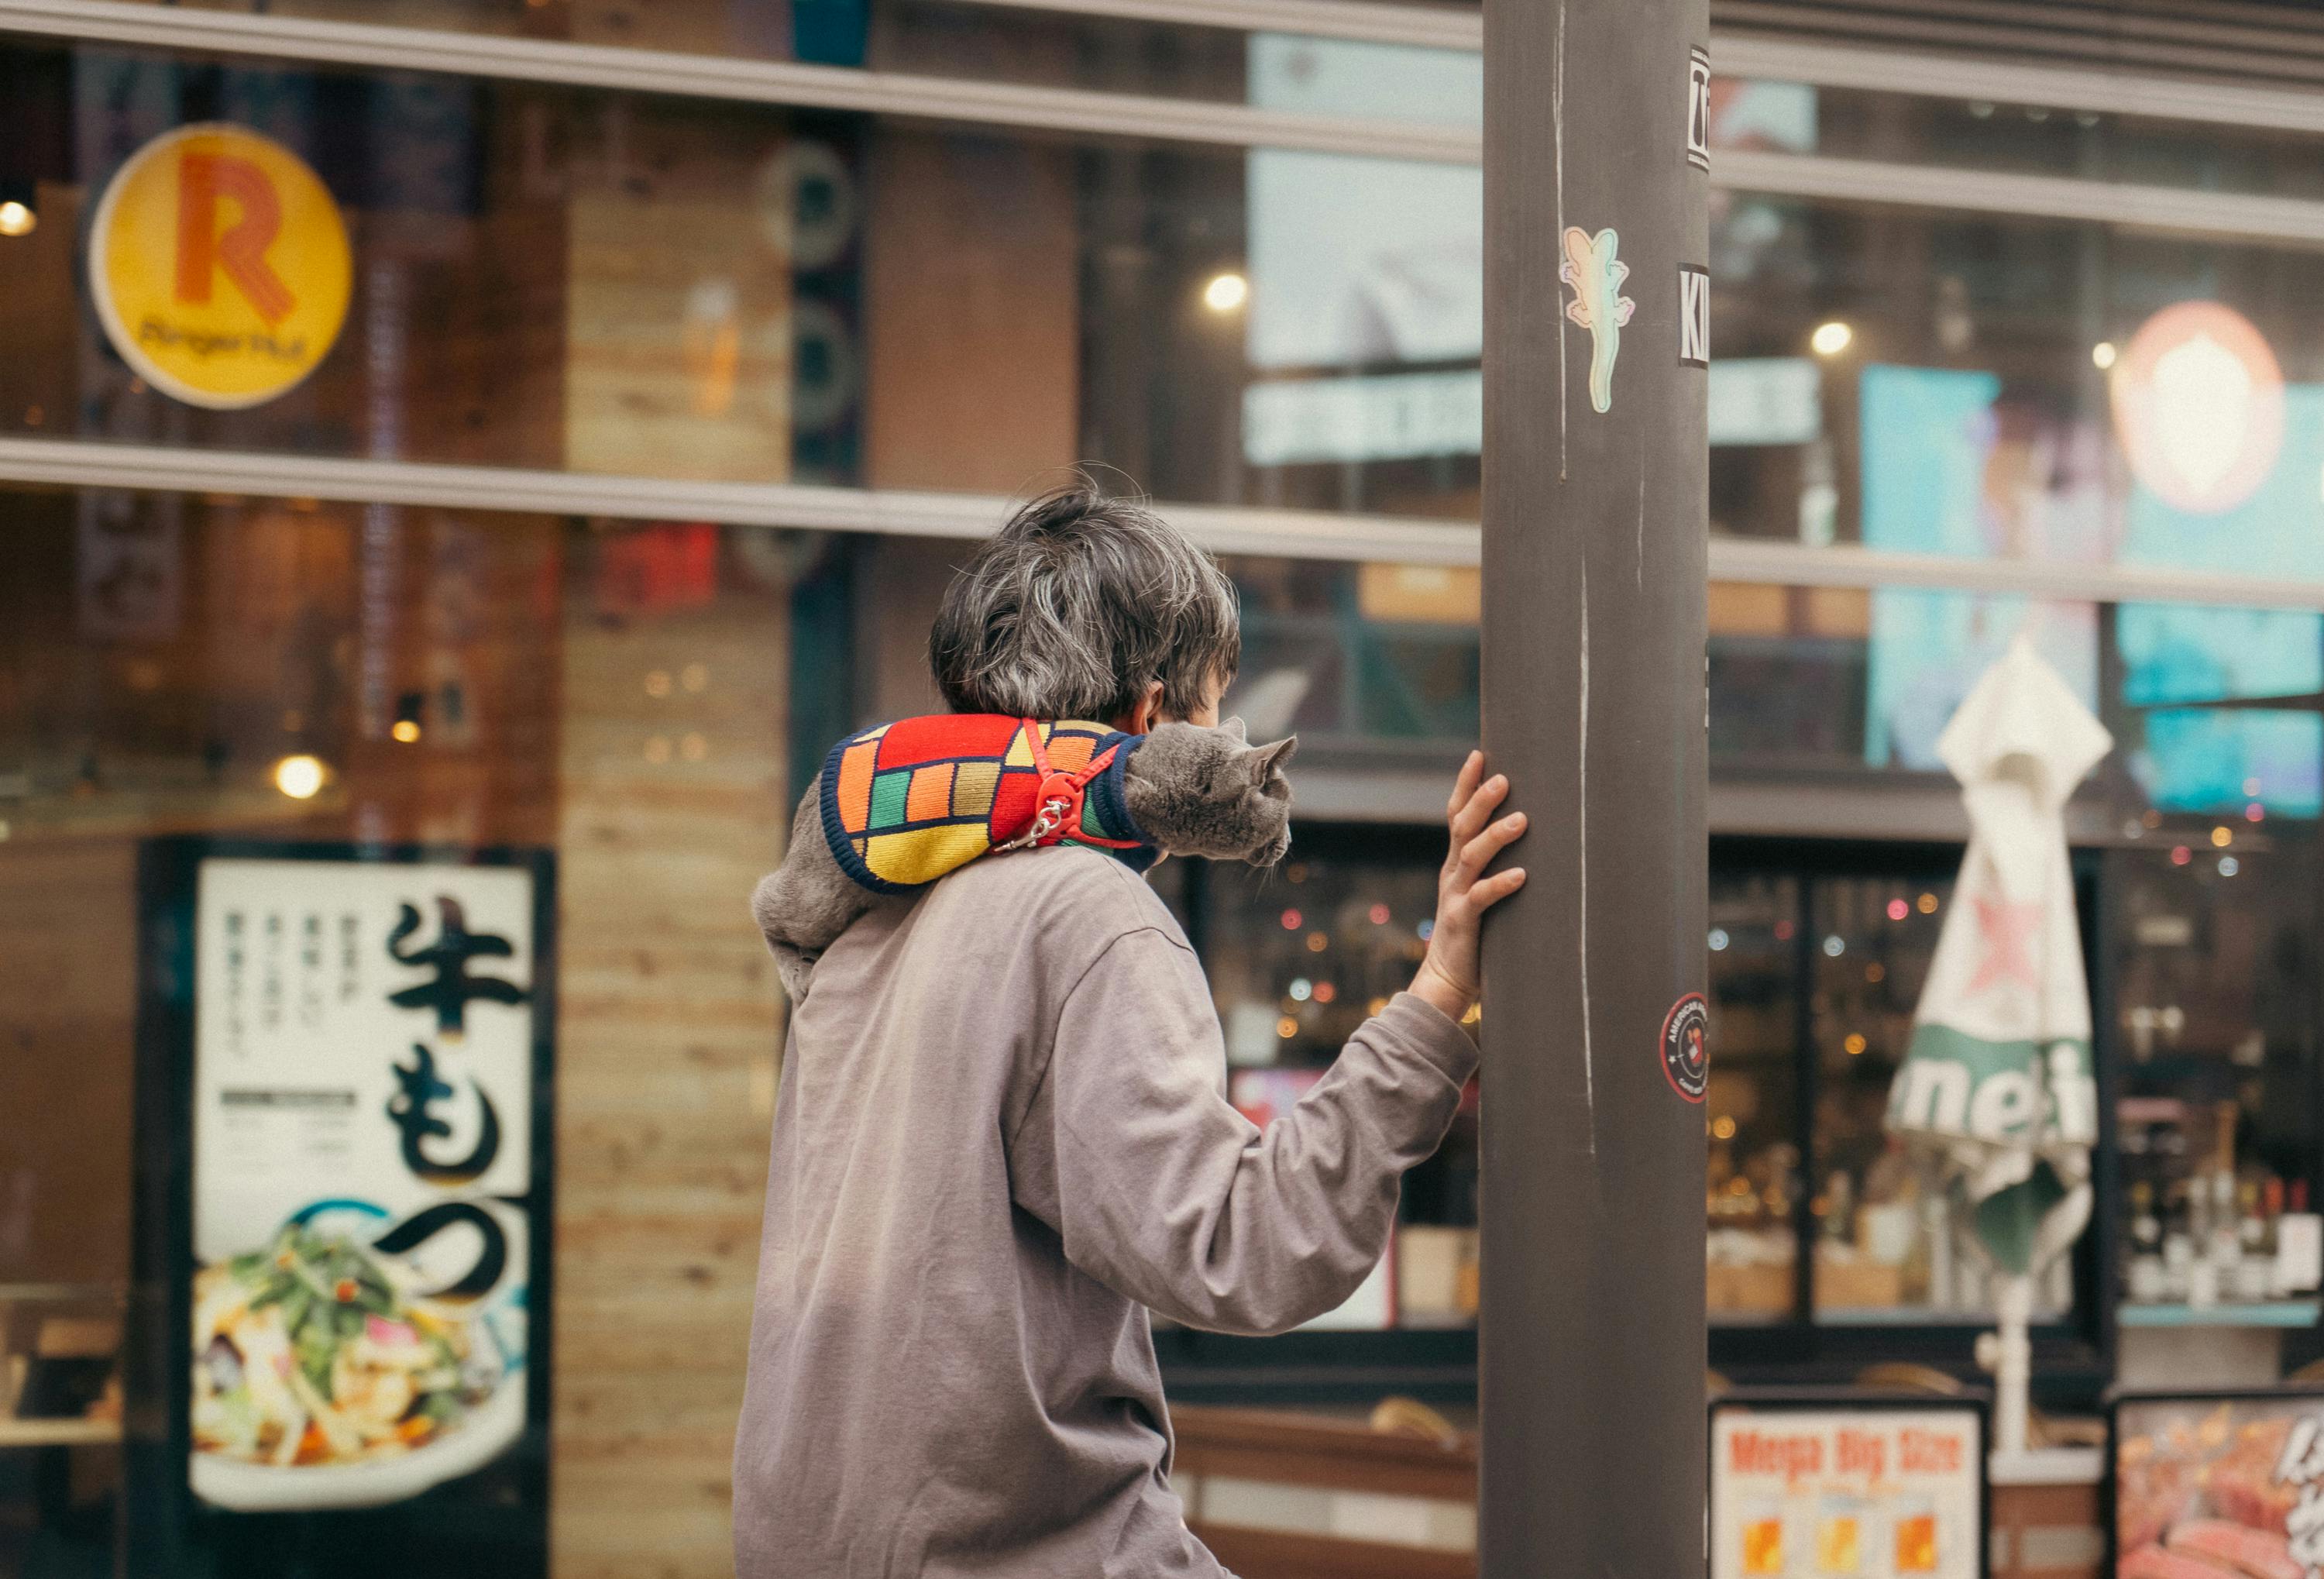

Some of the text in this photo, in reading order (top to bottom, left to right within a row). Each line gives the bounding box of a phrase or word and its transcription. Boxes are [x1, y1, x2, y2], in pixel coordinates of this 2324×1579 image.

[175, 155, 297, 329] R
[372, 896, 533, 1307] 牛もつ
[1730, 1429, 1963, 1484] Mega Big Size
